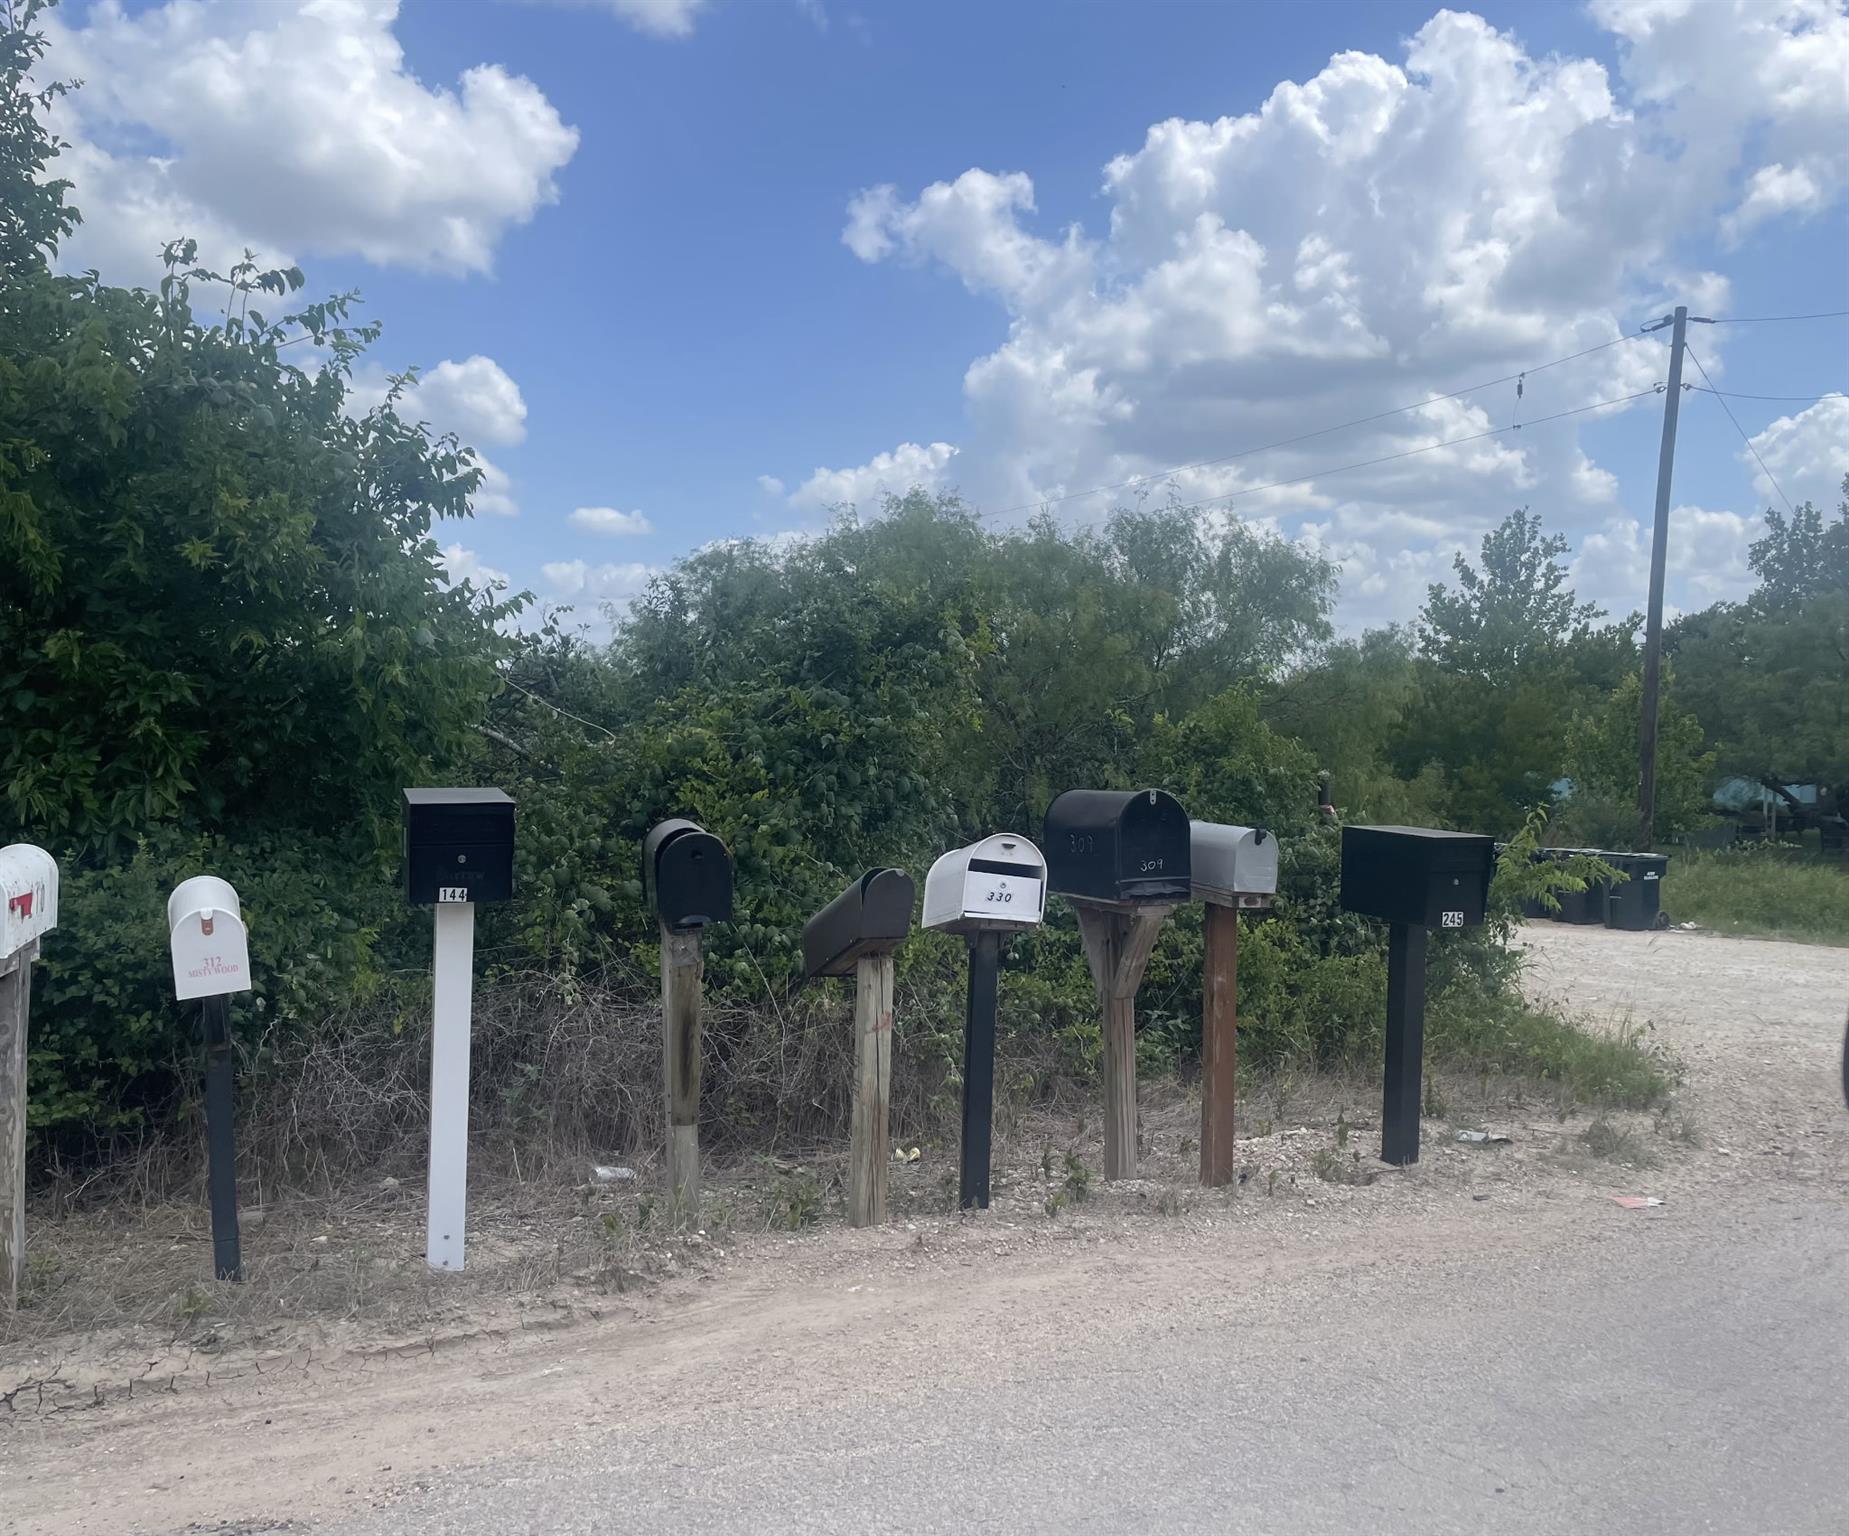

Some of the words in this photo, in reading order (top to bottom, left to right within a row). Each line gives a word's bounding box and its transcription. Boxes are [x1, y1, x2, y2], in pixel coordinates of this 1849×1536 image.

[1140, 858, 1164, 872] 309
[442, 889, 467, 901] 144
[987, 891, 1012, 902] 330
[1443, 912, 1464, 926] 245
[203, 956, 222, 968] 312
[188, 966, 212, 978] MISTY
[214, 964, 239, 975] WOOD
